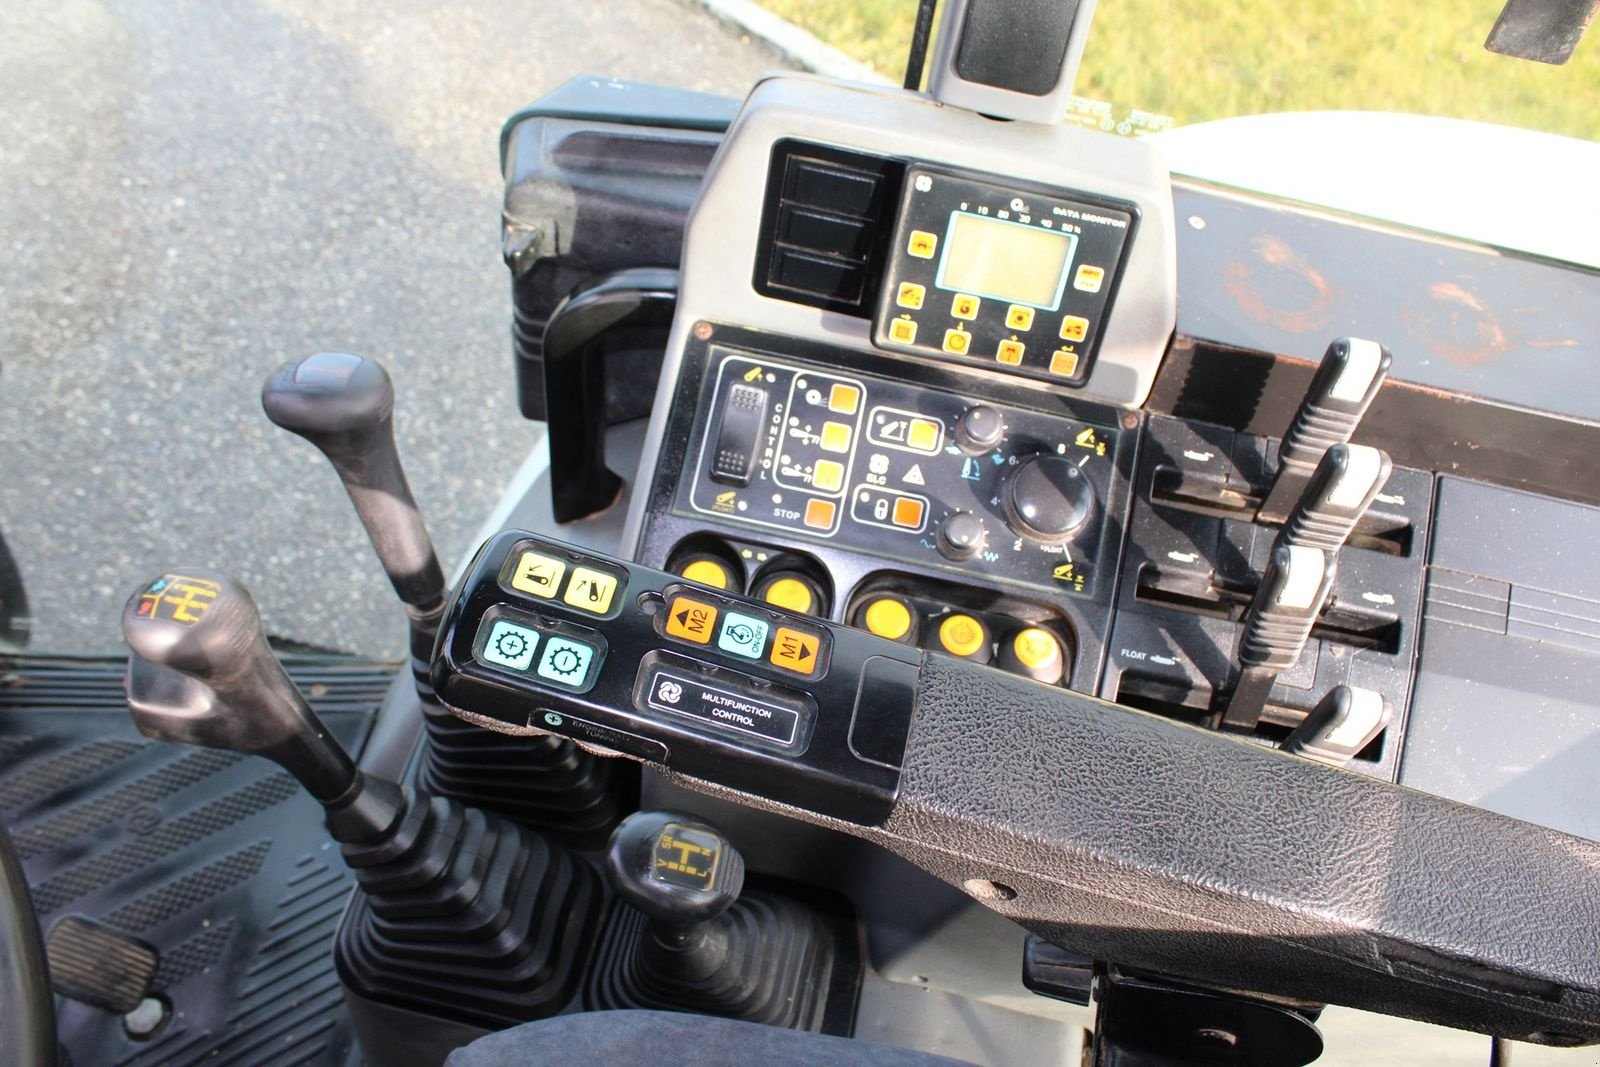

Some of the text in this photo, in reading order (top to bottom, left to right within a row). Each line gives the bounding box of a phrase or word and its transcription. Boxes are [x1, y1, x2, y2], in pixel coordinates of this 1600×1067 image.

[977, 205, 989, 215] 10
[1019, 213, 1031, 224] 30
[1041, 218, 1053, 229] 40
[1052, 206, 1127, 229] DATA MONITOR
[760, 403, 783, 480] CONTROL
[1008, 455, 1017, 465] 6
[866, 473, 887, 485] ELC
[990, 496, 998, 506] 4
[773, 507, 801, 520] STOP
[1013, 540, 1023, 551] 2
[687, 609, 709, 634] M2
[751, 625, 765, 653] ON-OFF
[780, 636, 799, 659] M1
[1120, 647, 1147, 661] FLOAT
[702, 692, 772, 719] MULTIFUNCTION
[712, 708, 755, 727] CONTROL
